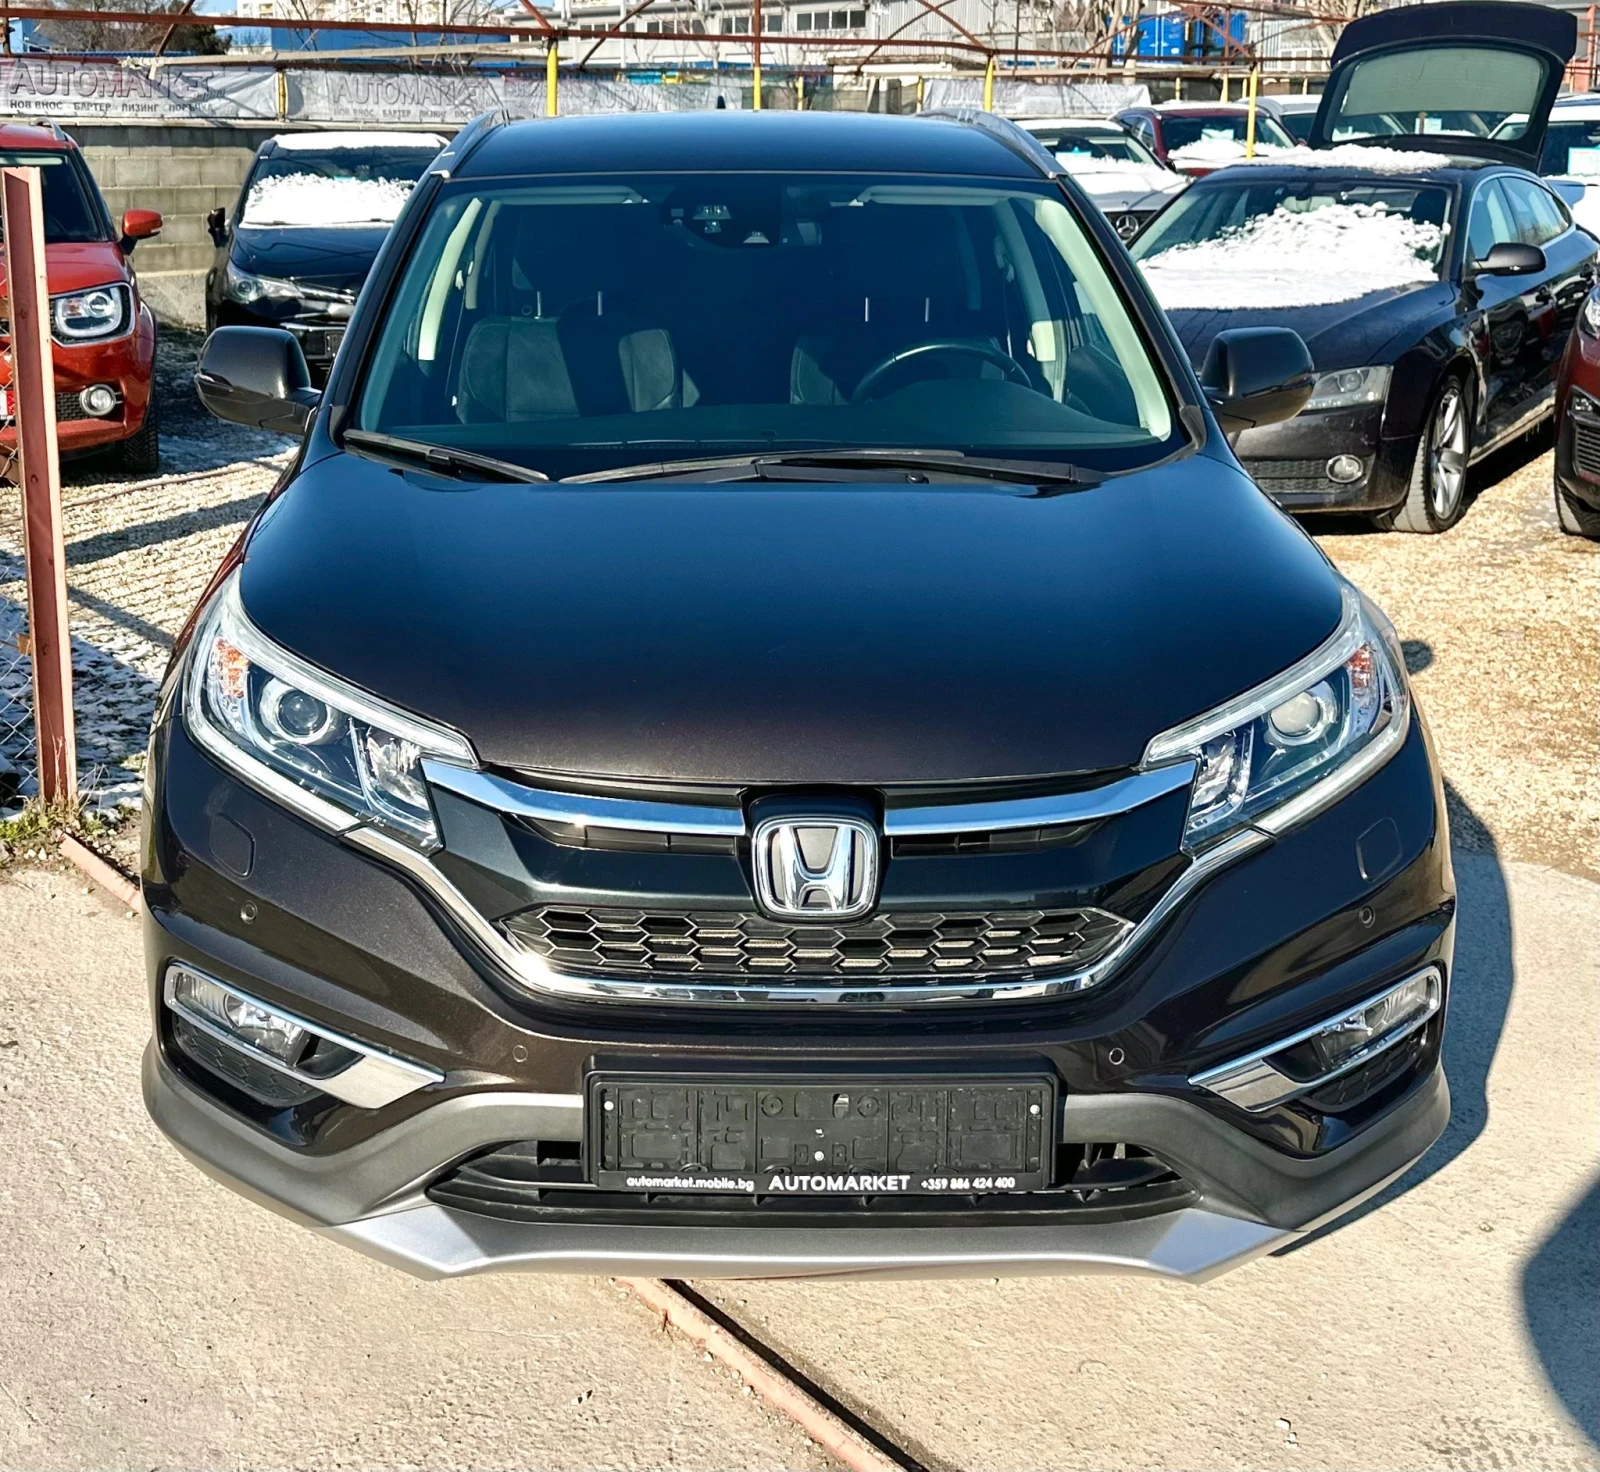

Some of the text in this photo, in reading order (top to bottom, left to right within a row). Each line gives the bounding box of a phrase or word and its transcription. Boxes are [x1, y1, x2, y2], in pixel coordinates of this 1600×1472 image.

[9, 61, 215, 99] AUTOMARKET
[10, 100, 32, 109] НОВ
[35, 101, 63, 110] ВНОС
[74, 102, 111, 112] БАРТЕР
[626, 1175, 755, 1192] automarket.mobile.bg
[768, 1175, 911, 1191] AUTOMARKET
[921, 1177, 948, 1190] +359
[972, 1176, 993, 1189] 424
[995, 1176, 1016, 1189] 400
